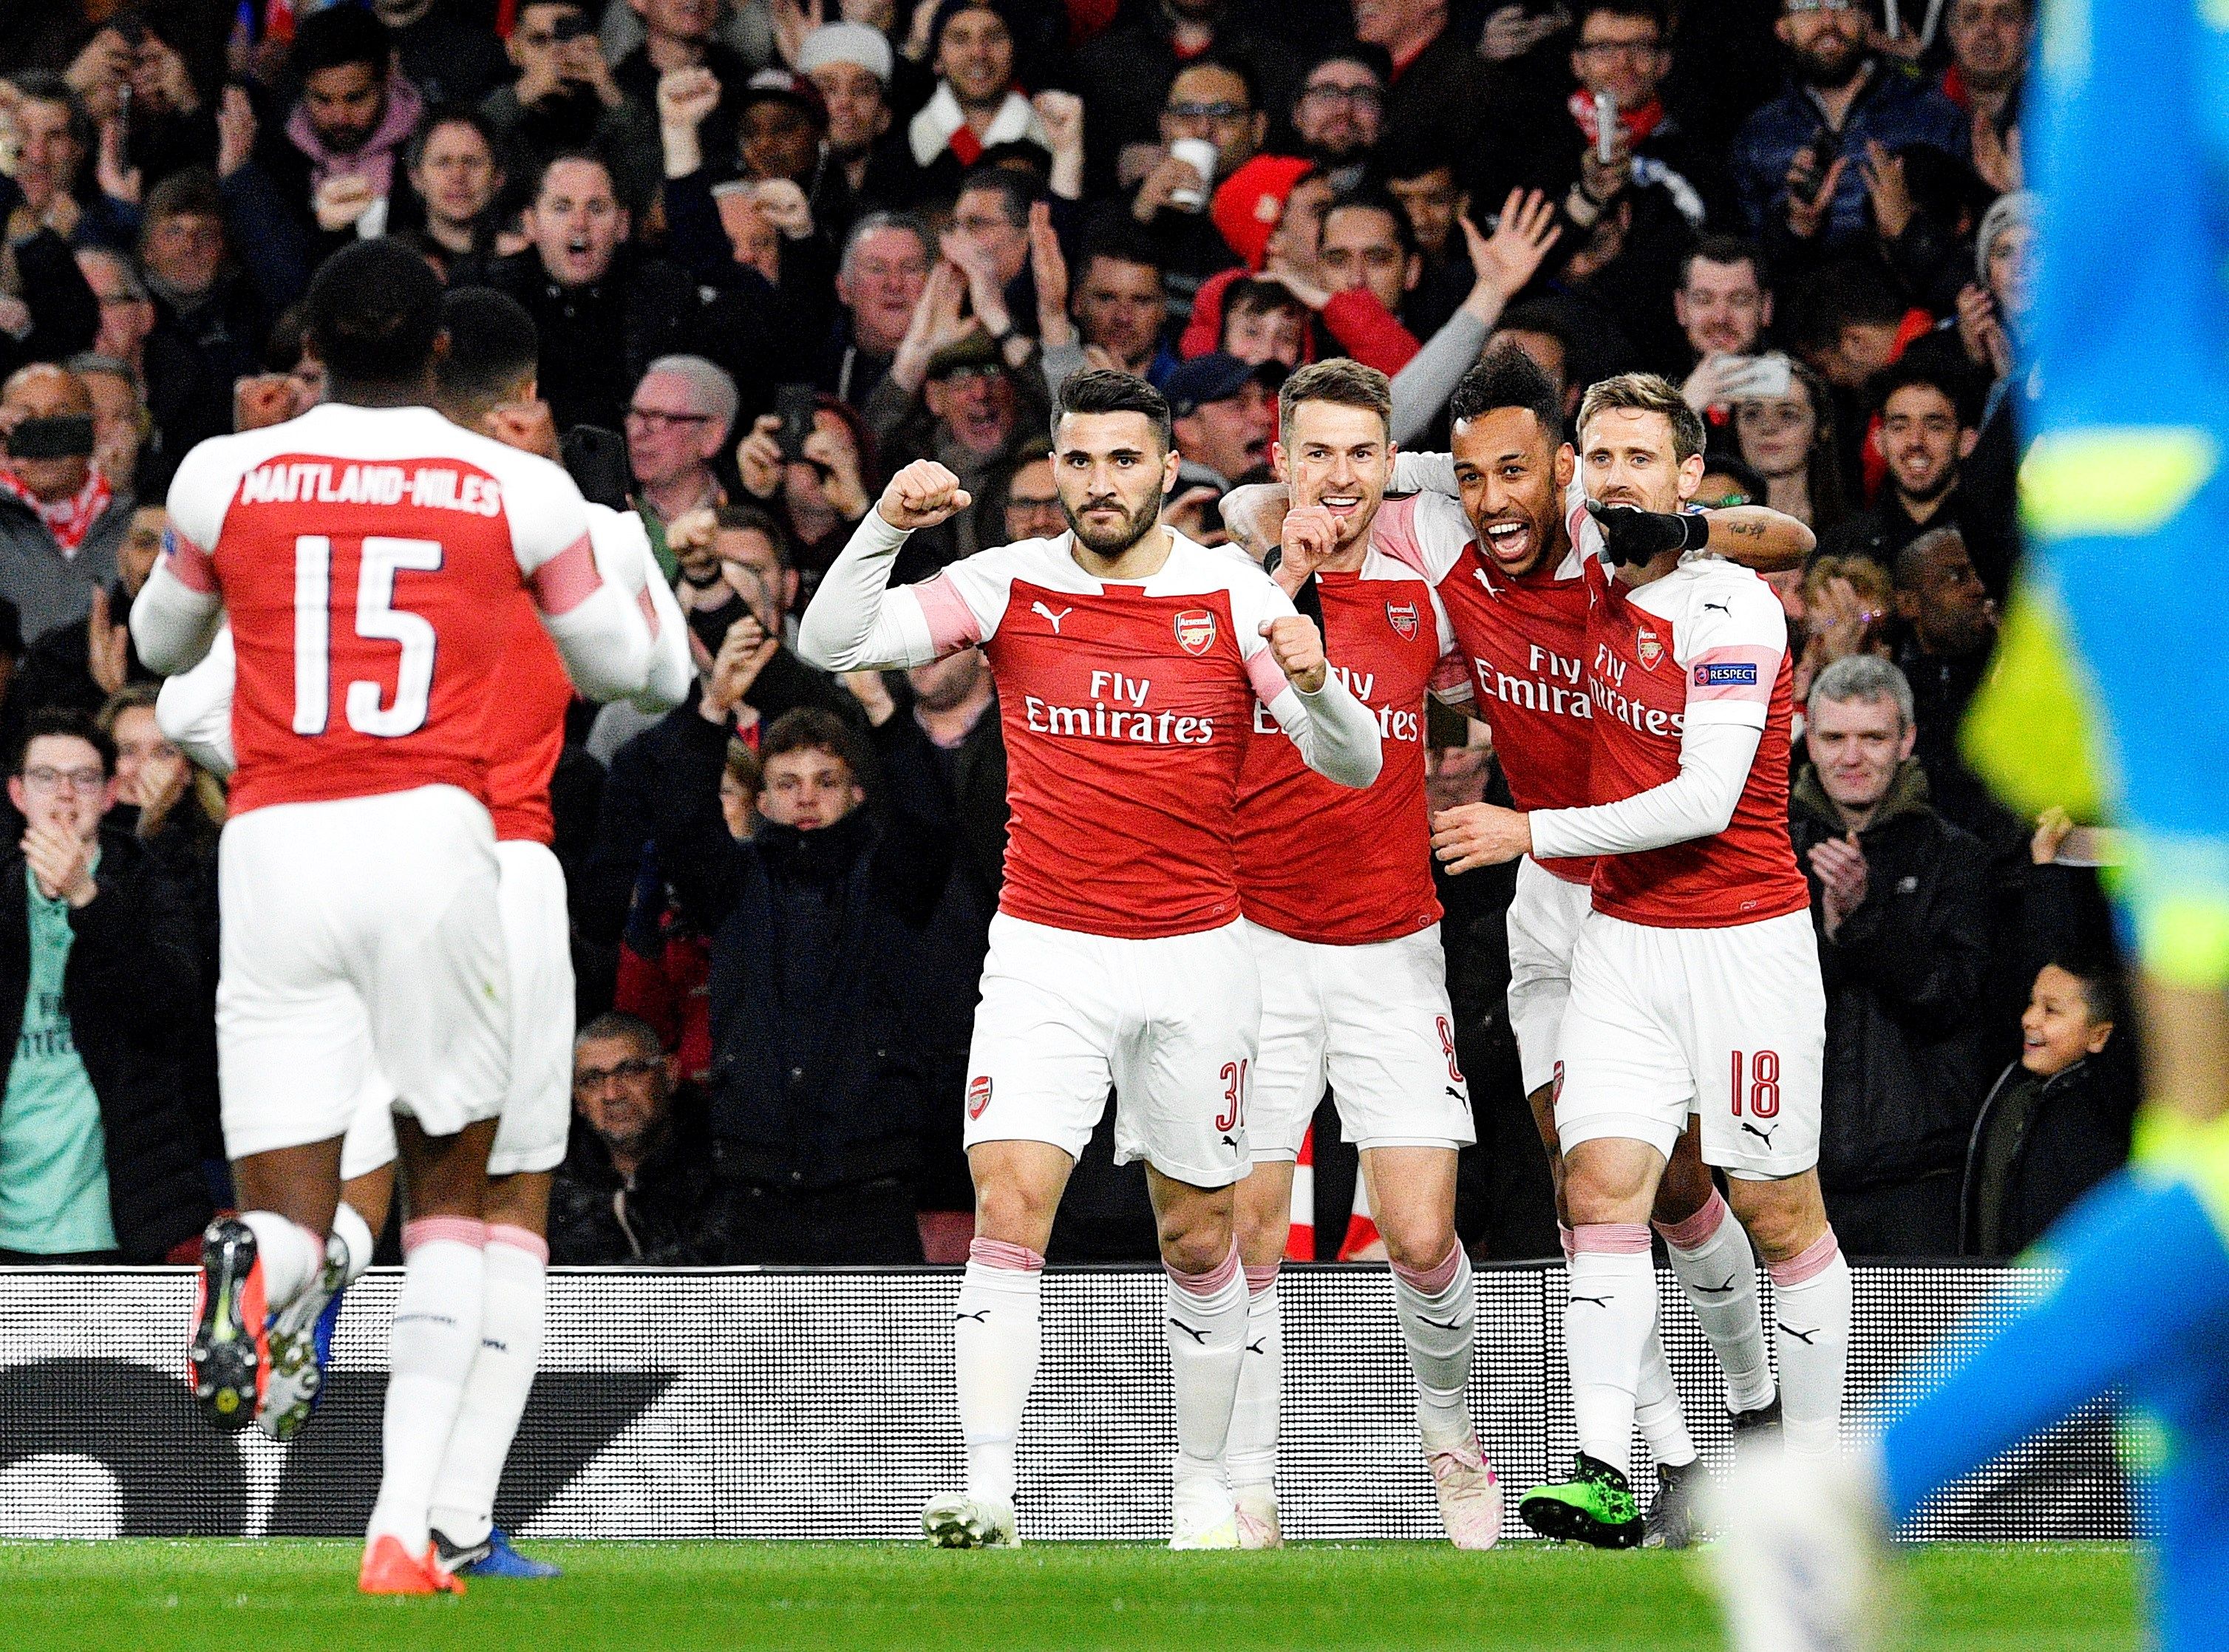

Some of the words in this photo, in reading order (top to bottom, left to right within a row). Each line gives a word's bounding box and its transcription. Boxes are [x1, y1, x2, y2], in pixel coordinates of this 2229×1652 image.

[241, 463, 503, 517] MAITLAND-NILES
[293, 535, 442, 738] 15
[1331, 667, 1374, 700] ly
[1474, 656, 1593, 718] Emira
[1529, 644, 1581, 684] Fly
[1595, 642, 1626, 687] Fly
[1710, 669, 1755, 680] RESPECT
[1089, 670, 1150, 708] Fly
[1587, 673, 1685, 737] mirates
[1024, 695, 1214, 744] Emirates
[1253, 698, 1418, 742] Etes
[1732, 1050, 1780, 1118] 18
